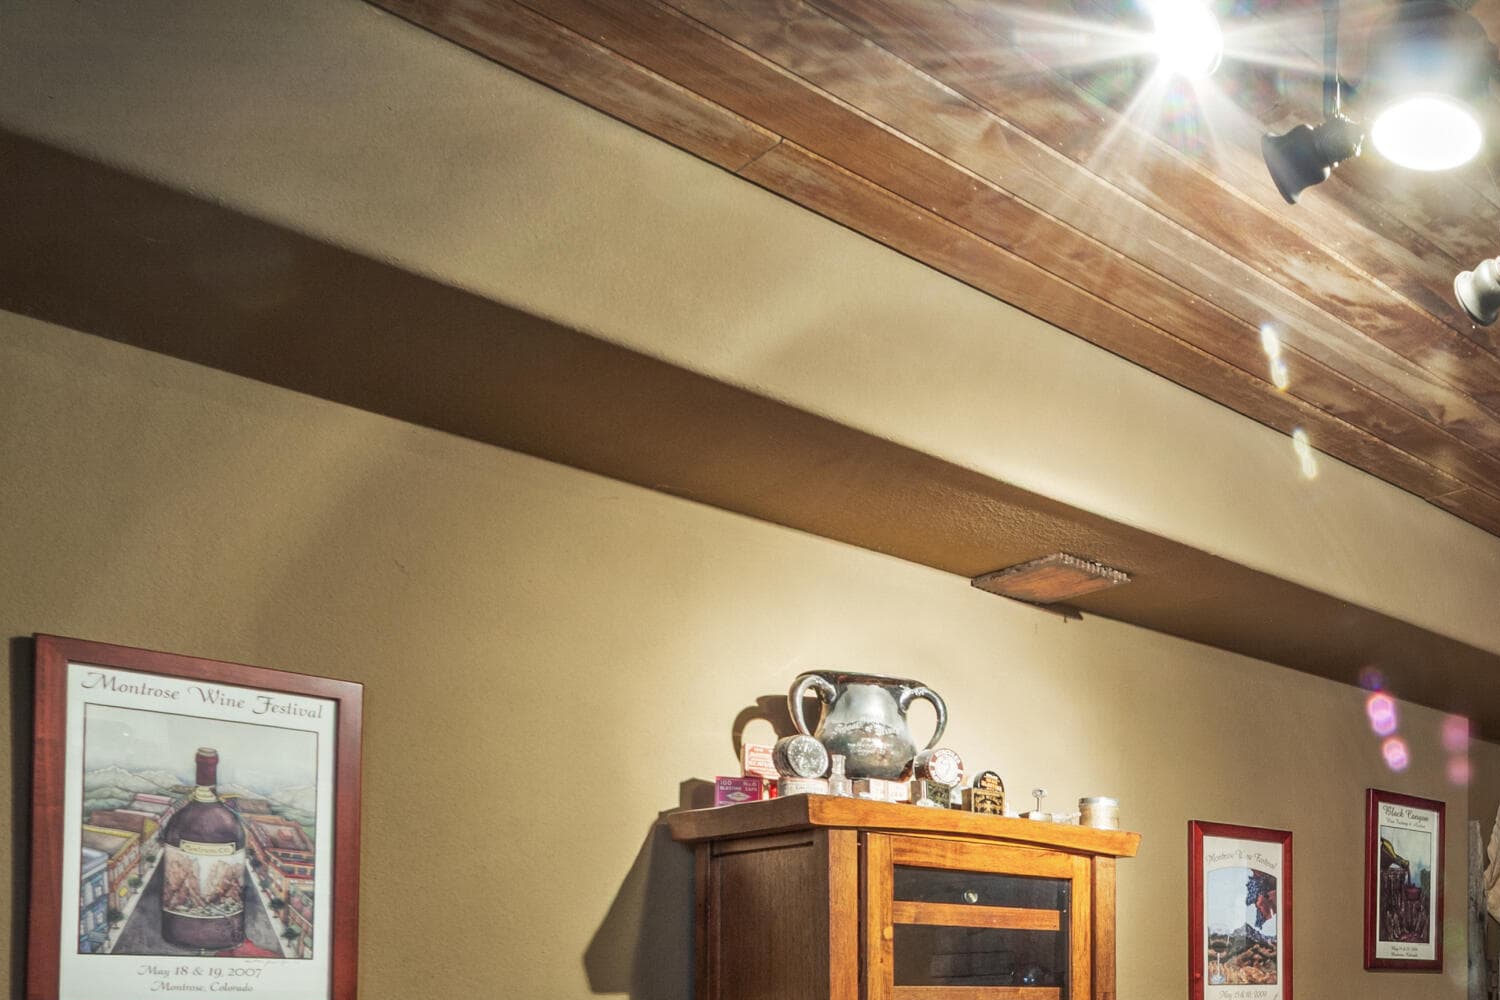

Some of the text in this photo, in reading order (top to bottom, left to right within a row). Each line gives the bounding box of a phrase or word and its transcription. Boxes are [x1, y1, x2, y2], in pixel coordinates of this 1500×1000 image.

[80, 672, 324, 720] Montrose Wine Festival
[136, 965, 170, 978] May
[174, 966, 189, 976] 18
[192, 966, 203, 976] &
[228, 967, 263, 979] 2007
[210, 981, 254, 992] Colorado
